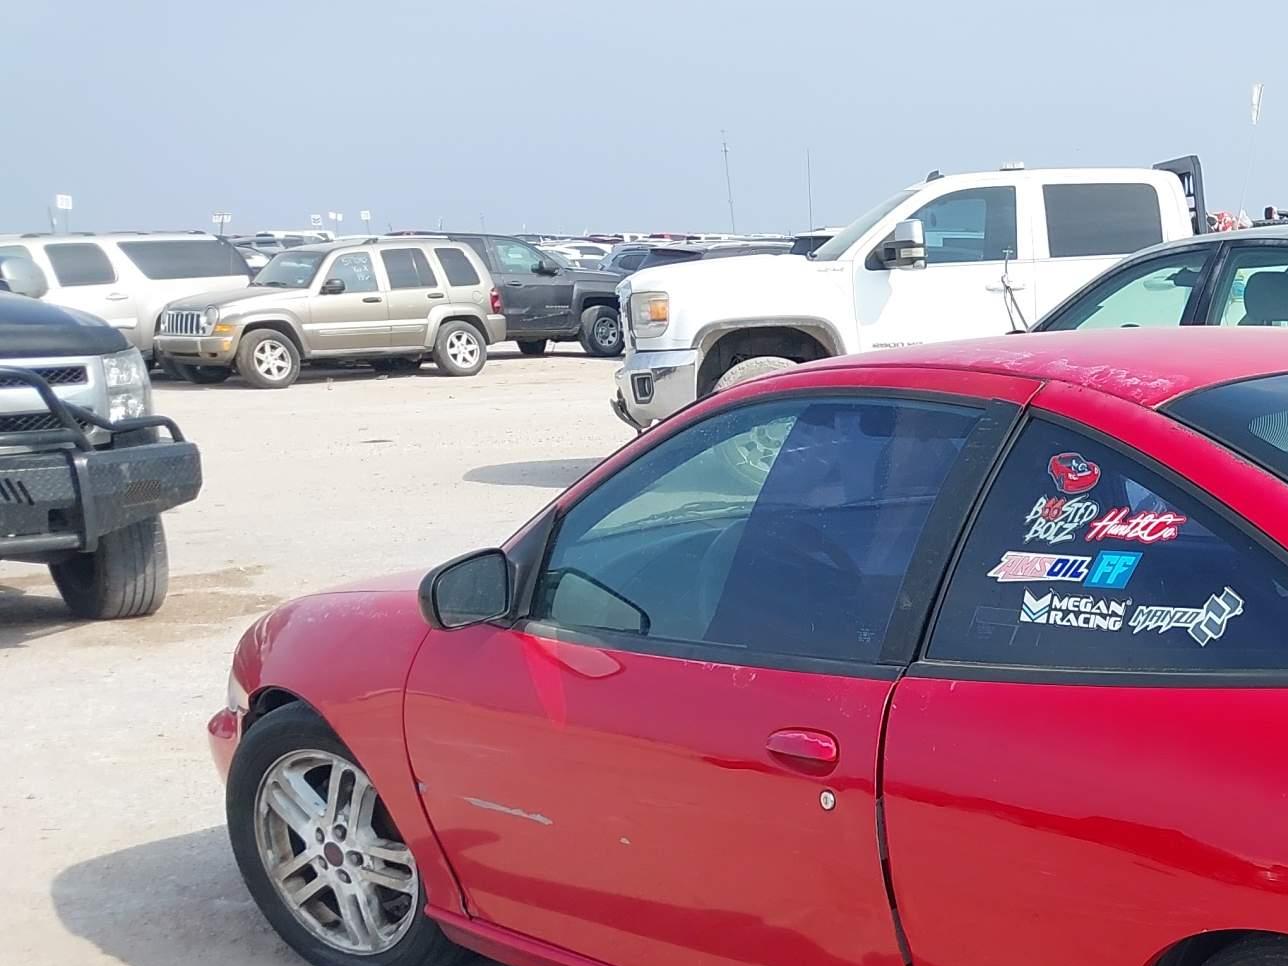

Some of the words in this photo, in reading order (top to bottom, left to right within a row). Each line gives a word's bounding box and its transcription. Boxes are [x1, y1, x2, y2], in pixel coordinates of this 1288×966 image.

[993, 554, 1089, 579] AMSOIL
[1091, 554, 1136, 584] FF
[1051, 595, 1125, 615] MEGAN
[1049, 610, 1123, 631] RACING
[1128, 606, 1204, 633] MANZO
